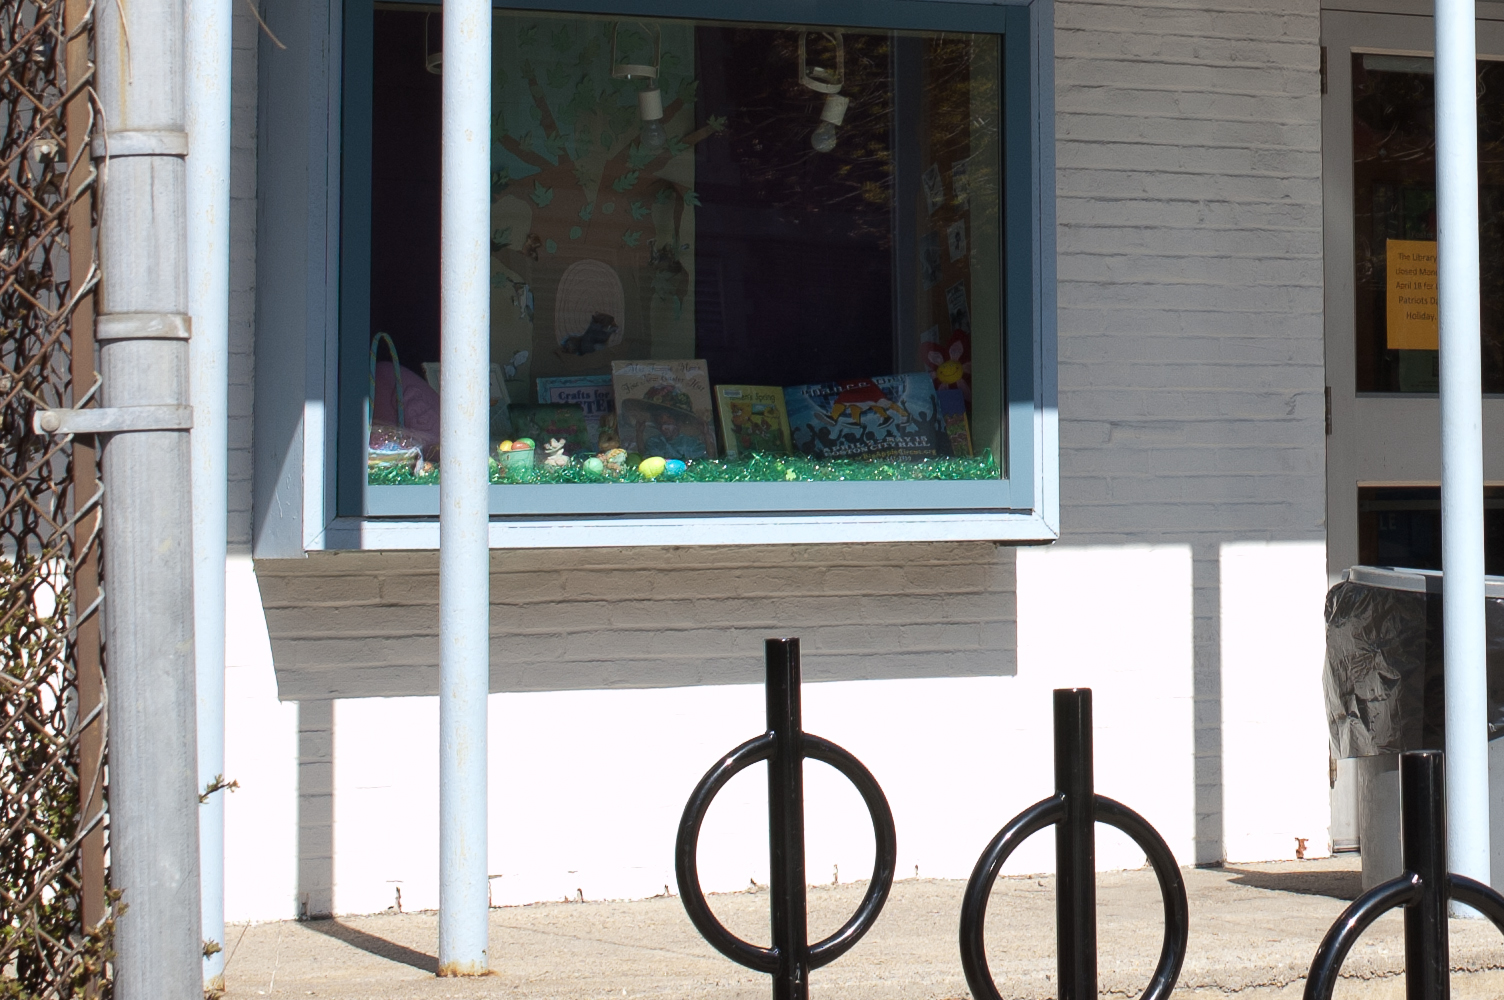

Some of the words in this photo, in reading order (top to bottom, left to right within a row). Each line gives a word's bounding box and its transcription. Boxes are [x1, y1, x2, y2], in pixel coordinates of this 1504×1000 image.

[1398, 252, 1411, 261] The
[1412, 252, 1438, 263] Library
[1396, 281, 1412, 291] April
[1398, 295, 1428, 305] Patriots
[1430, 296, 1439, 306] Da
[558, 389, 591, 400] Crafts
[594, 389, 610, 400] for
[885, 435, 911, 443] MAY
[869, 442, 896, 451] CITY
[897, 440, 931, 448] HALL
